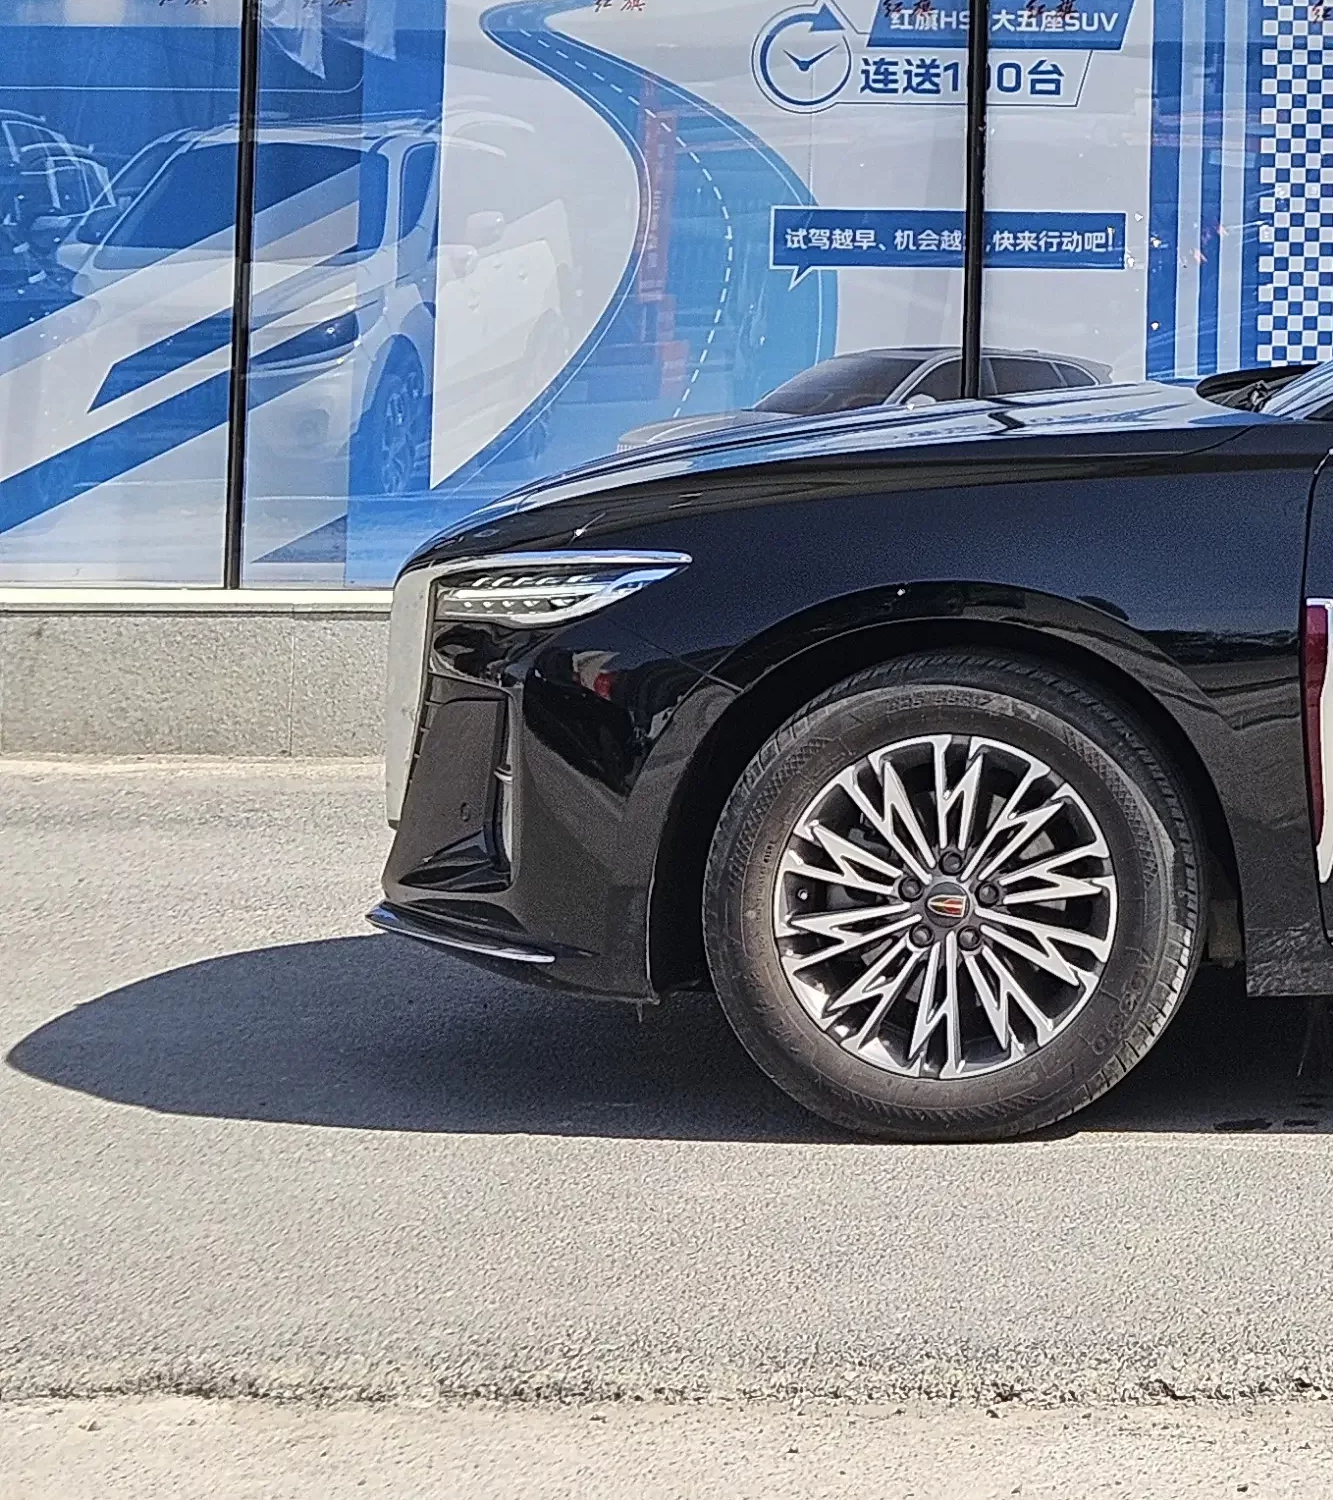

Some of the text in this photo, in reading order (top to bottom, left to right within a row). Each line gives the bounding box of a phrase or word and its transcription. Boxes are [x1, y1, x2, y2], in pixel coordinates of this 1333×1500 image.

[890, 8, 1118, 33] 红旗HS大五座SUV
[860, 58, 1065, 96] 连送10台
